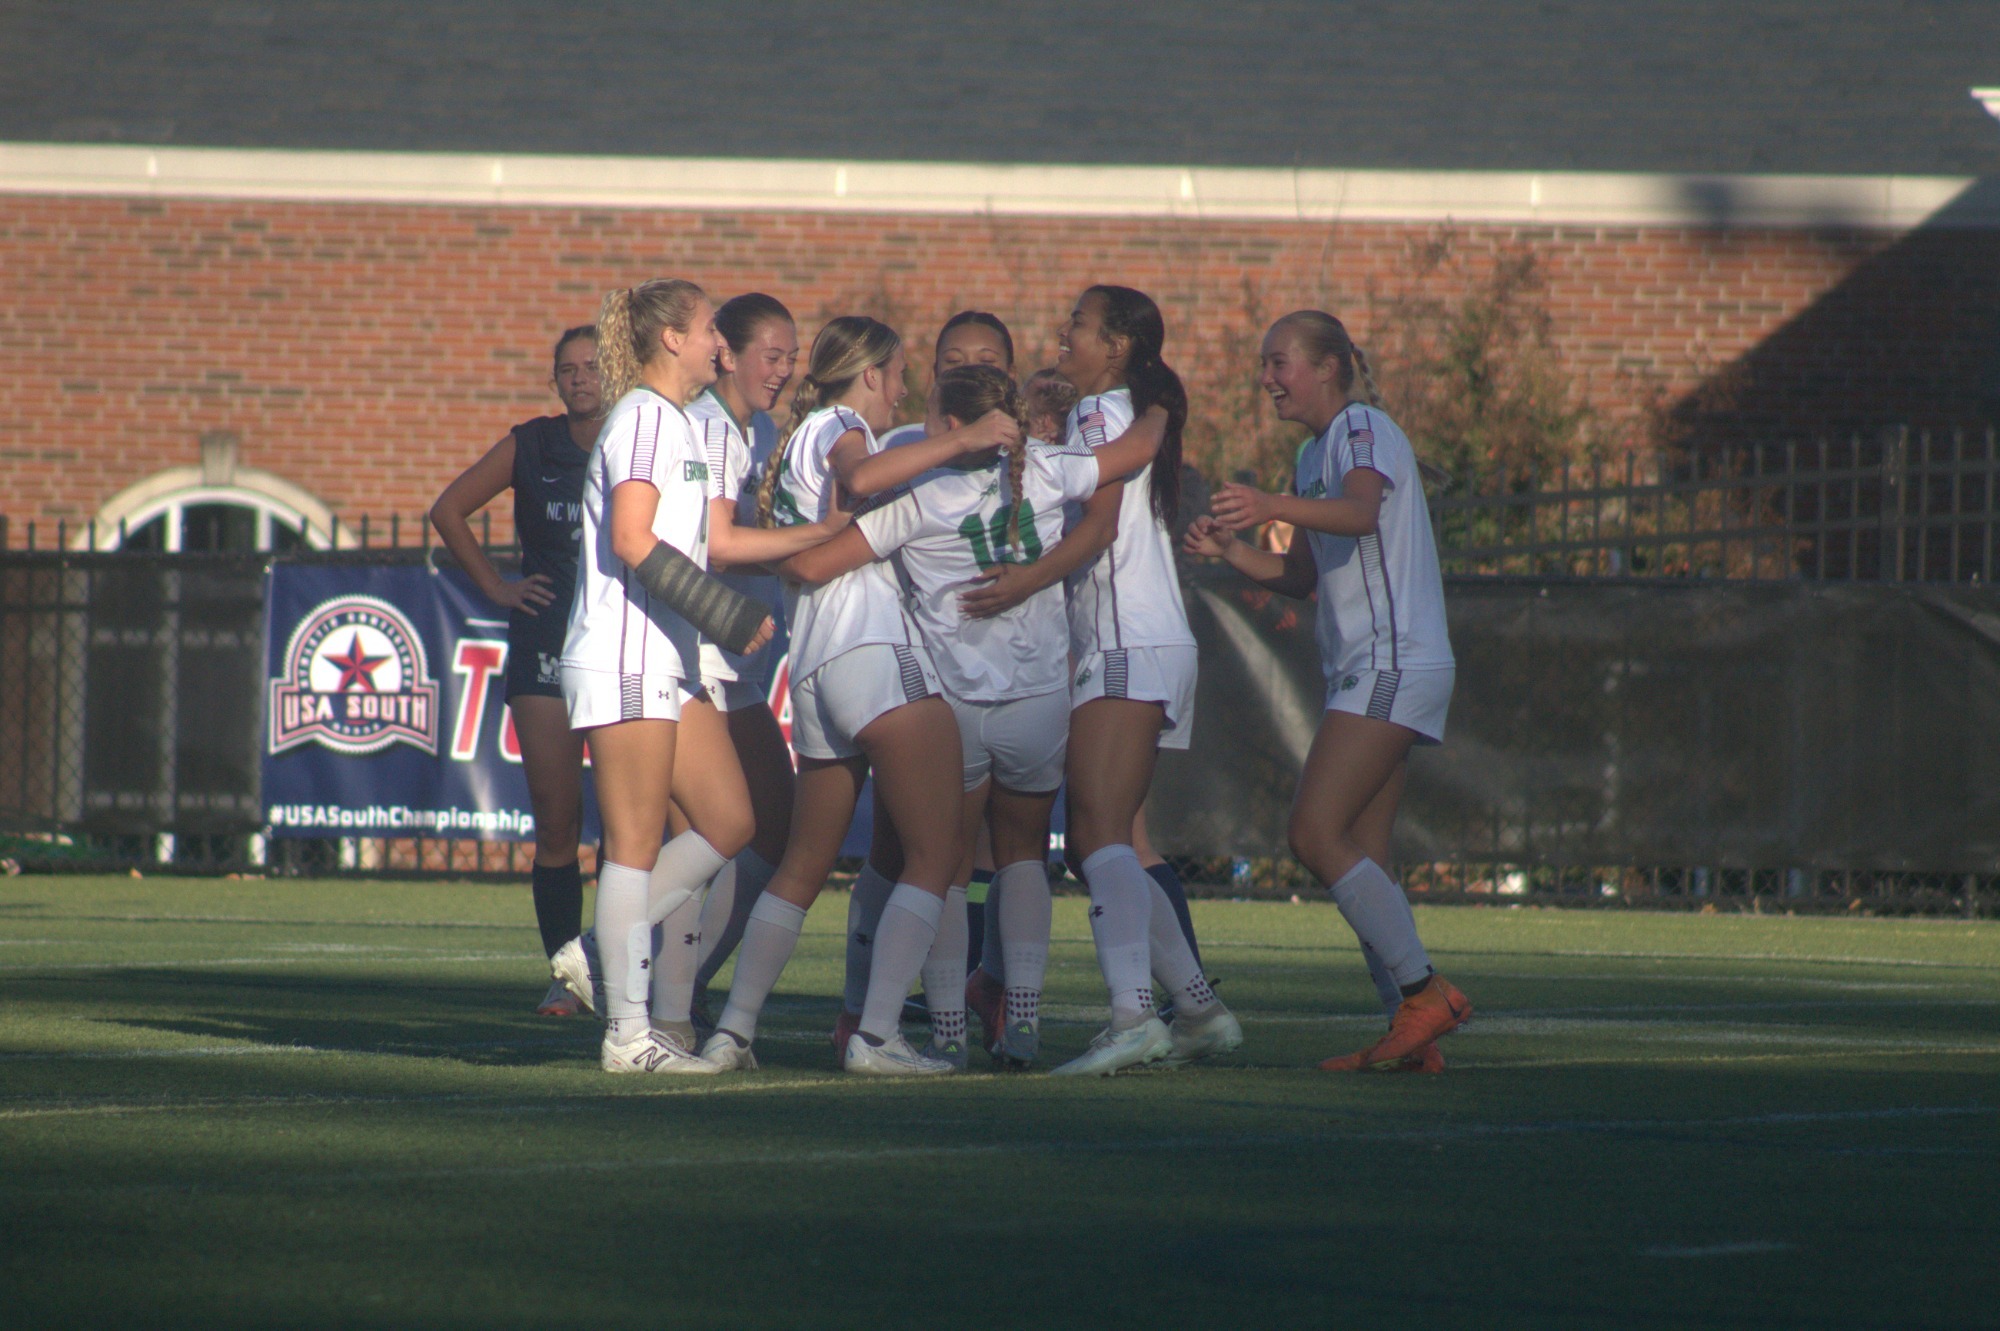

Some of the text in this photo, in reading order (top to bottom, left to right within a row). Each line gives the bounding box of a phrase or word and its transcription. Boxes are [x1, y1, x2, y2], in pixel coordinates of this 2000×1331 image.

[546, 501, 564, 520] NC
[284, 694, 427, 732] USA SOUTH
